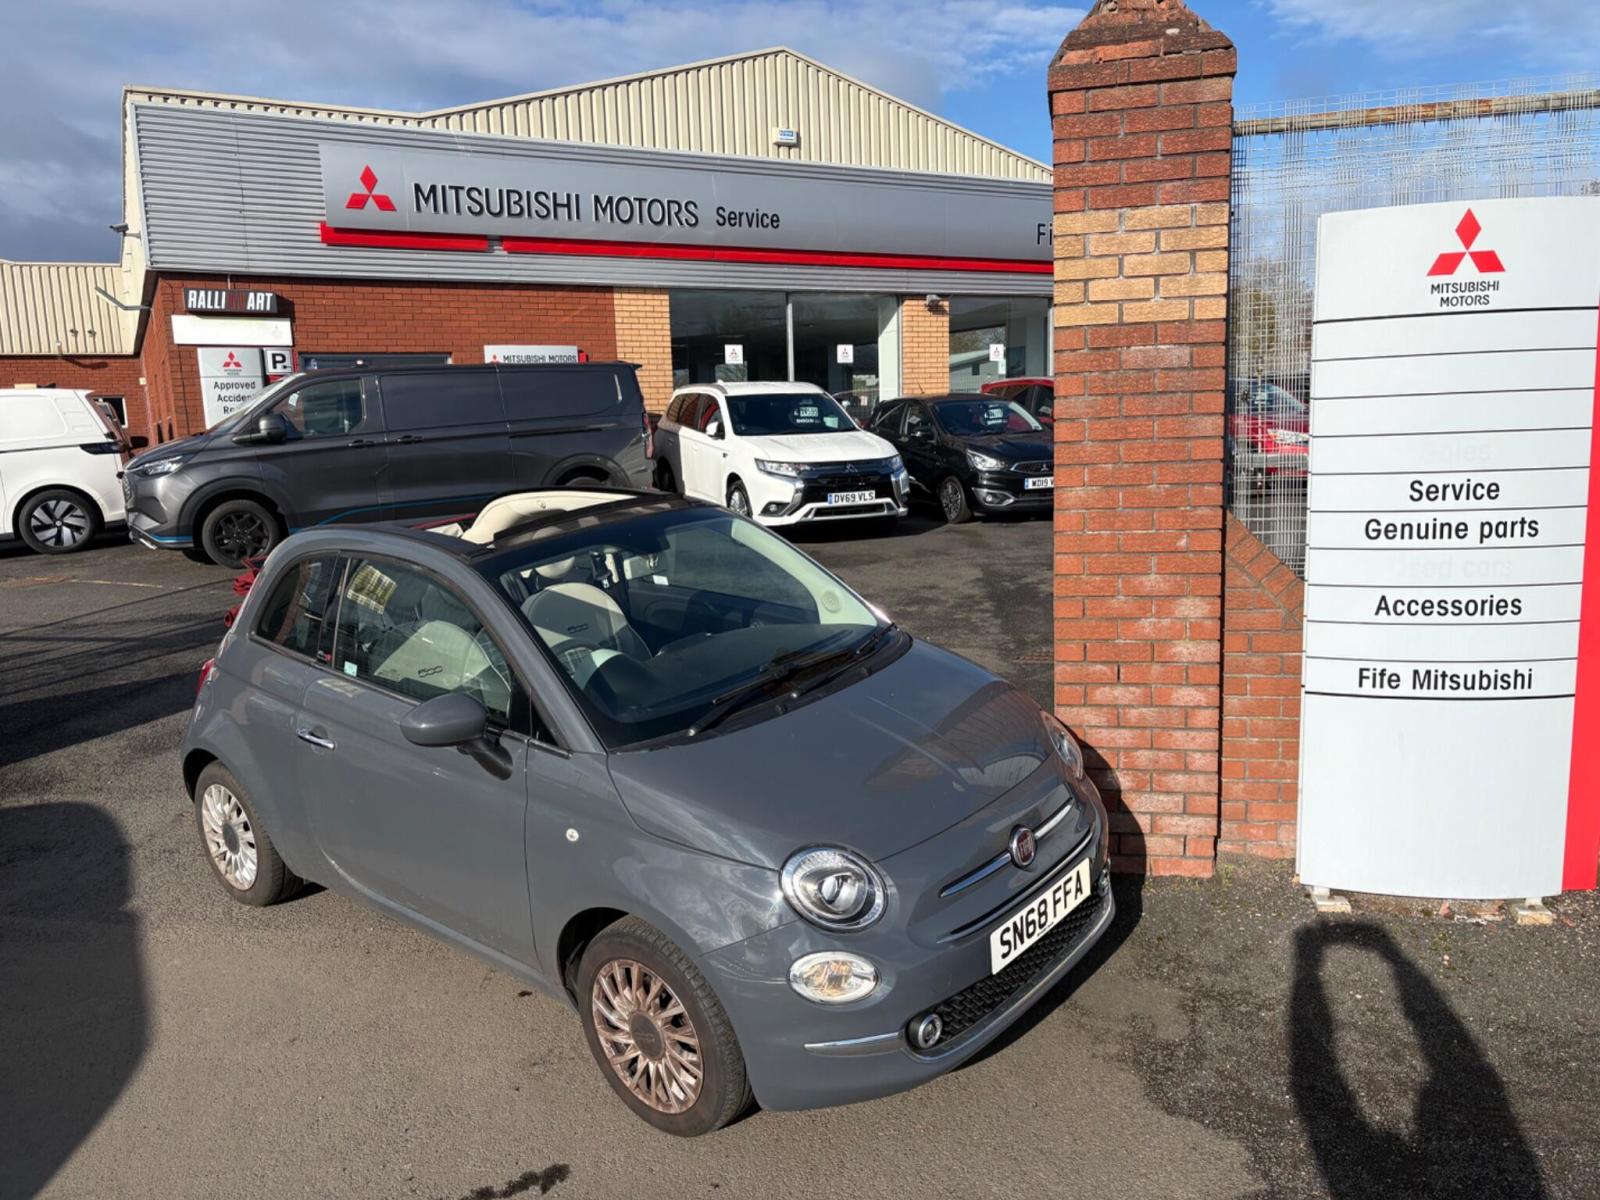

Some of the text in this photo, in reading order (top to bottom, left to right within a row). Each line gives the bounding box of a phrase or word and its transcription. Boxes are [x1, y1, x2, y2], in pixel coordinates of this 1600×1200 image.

[413, 182, 780, 229] MITSUBISHI MOTORS Service
[1037, 223, 1053, 246] Fi
[1430, 280, 1500, 295] MITSUBISHI
[1440, 294, 1490, 308] MOTORS
[503, 354, 577, 363] MITSUBISHI MOTORS
[213, 381, 256, 391] Approved
[834, 491, 874, 503] DV69 VLS
[1409, 479, 1500, 502] Service
[1364, 517, 1539, 544] Genuine parts
[1374, 595, 1522, 616] Accessories
[1358, 668, 1533, 691] Fife Mitsubishi
[1000, 870, 1083, 960] SN68 FFA
